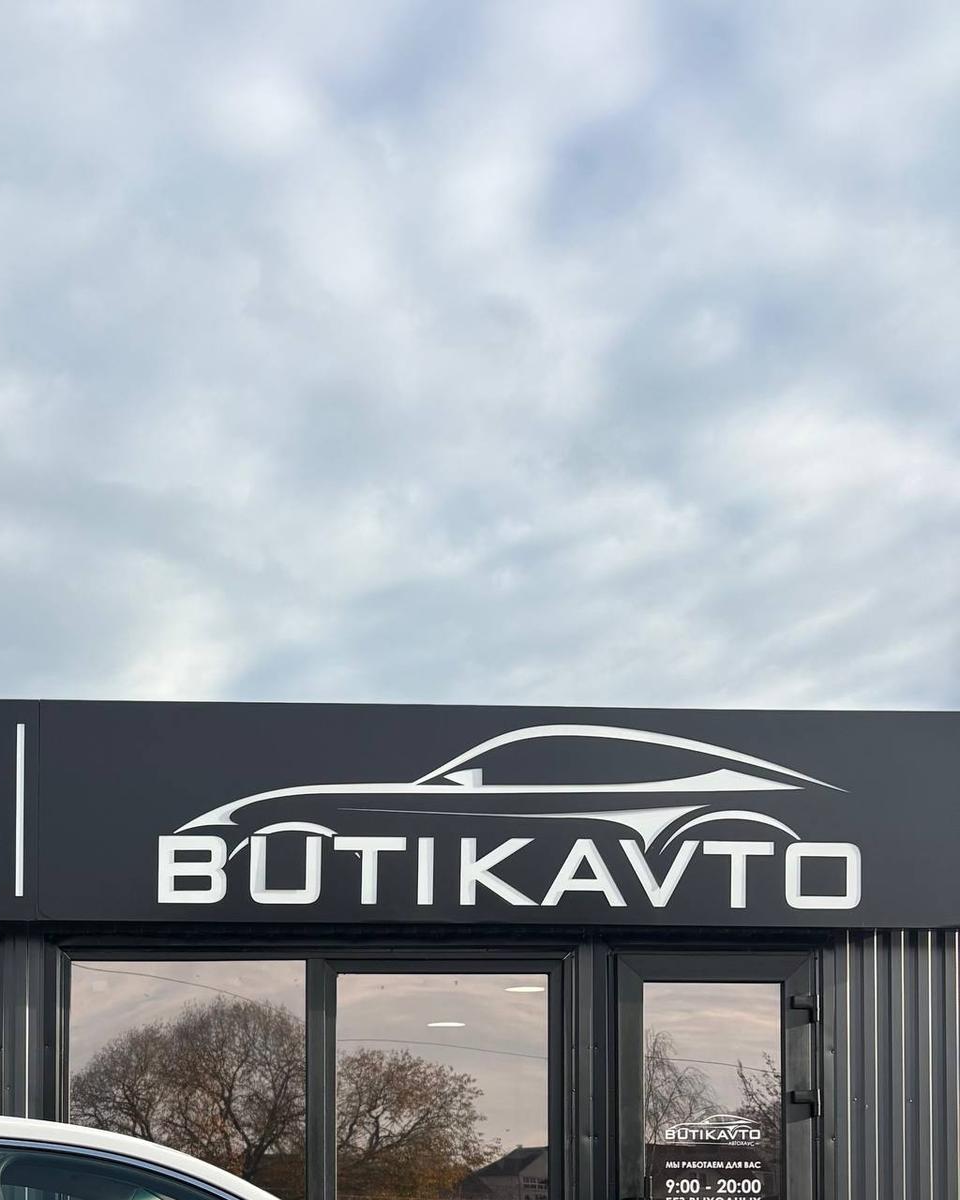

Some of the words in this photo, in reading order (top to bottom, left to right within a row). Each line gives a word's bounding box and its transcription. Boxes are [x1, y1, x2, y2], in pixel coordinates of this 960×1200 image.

[157, 835, 862, 910] BUTIKAVTO
[665, 1129, 761, 1140] BUTIKAVTO
[665, 1161, 680, 1169] МЫ
[681, 1161, 724, 1169] РАБОТАЕМ
[725, 1161, 742, 1170] ДЛЯ
[743, 1161, 761, 1169] ВАС
[665, 1179, 700, 1194] 9:00
[716, 1179, 762, 1194] 20:00
